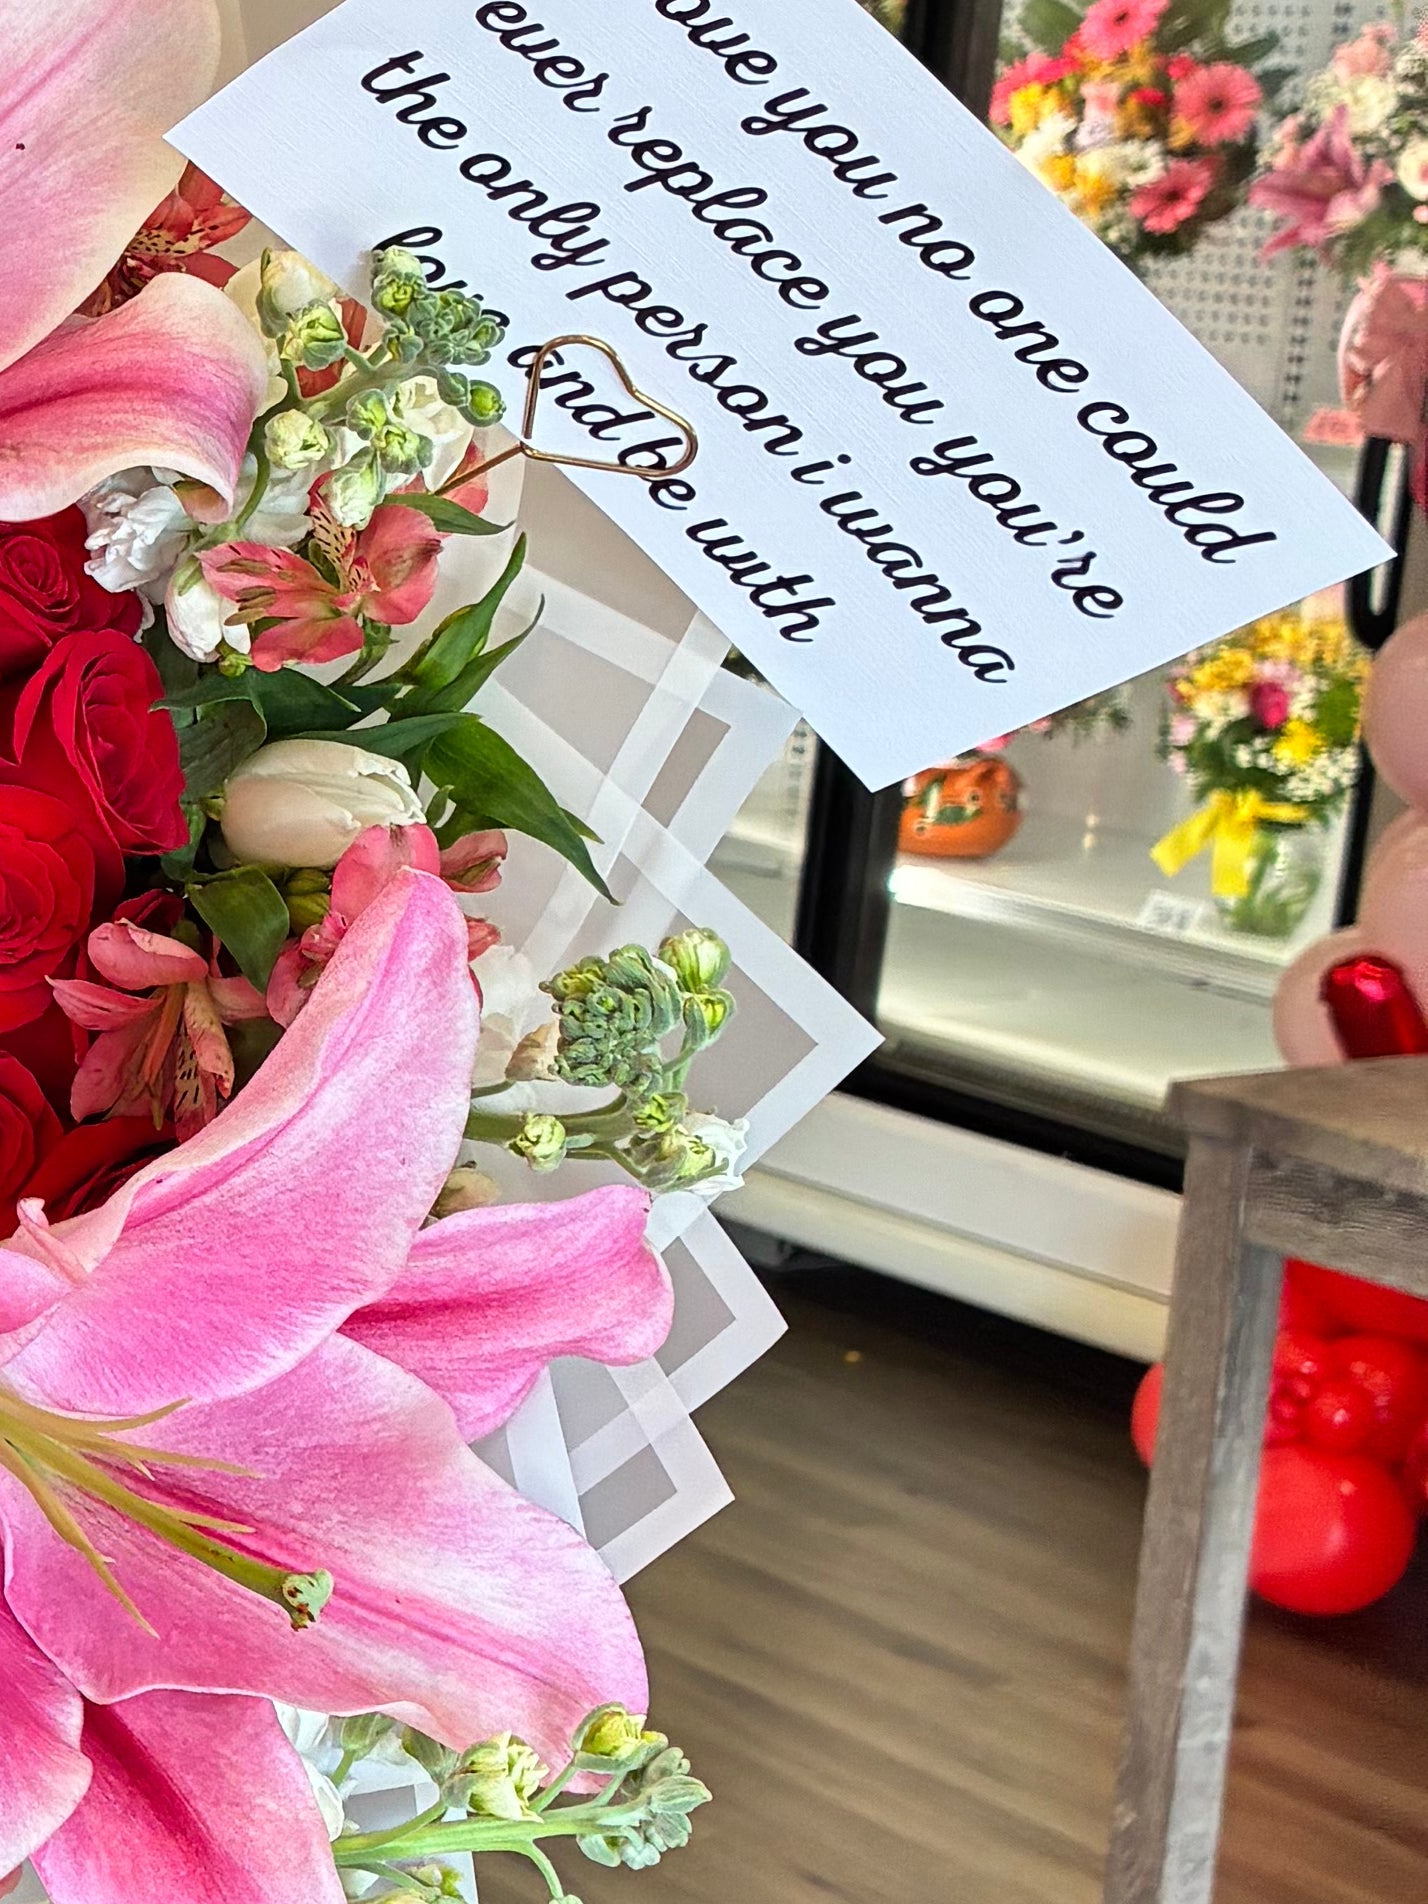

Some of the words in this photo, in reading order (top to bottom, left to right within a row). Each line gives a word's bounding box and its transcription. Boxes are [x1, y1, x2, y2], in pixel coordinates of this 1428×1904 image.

[361, 51, 467, 149] the
[460, 154, 609, 270] only
[476, 1, 609, 112] ever
[608, 106, 829, 309] replace
[794, 315, 944, 424] you
[910, 436, 1123, 618] you're
[566, 272, 802, 455] person
[741, 88, 897, 199] you
[879, 204, 975, 280] no
[969, 291, 1088, 392] one
[1077, 402, 1276, 563] could
[507, 345, 656, 441] and
[618, 437, 697, 510] be
[686, 519, 835, 642] with
[791, 453, 851, 484] i
[820, 491, 1014, 683] wanna
